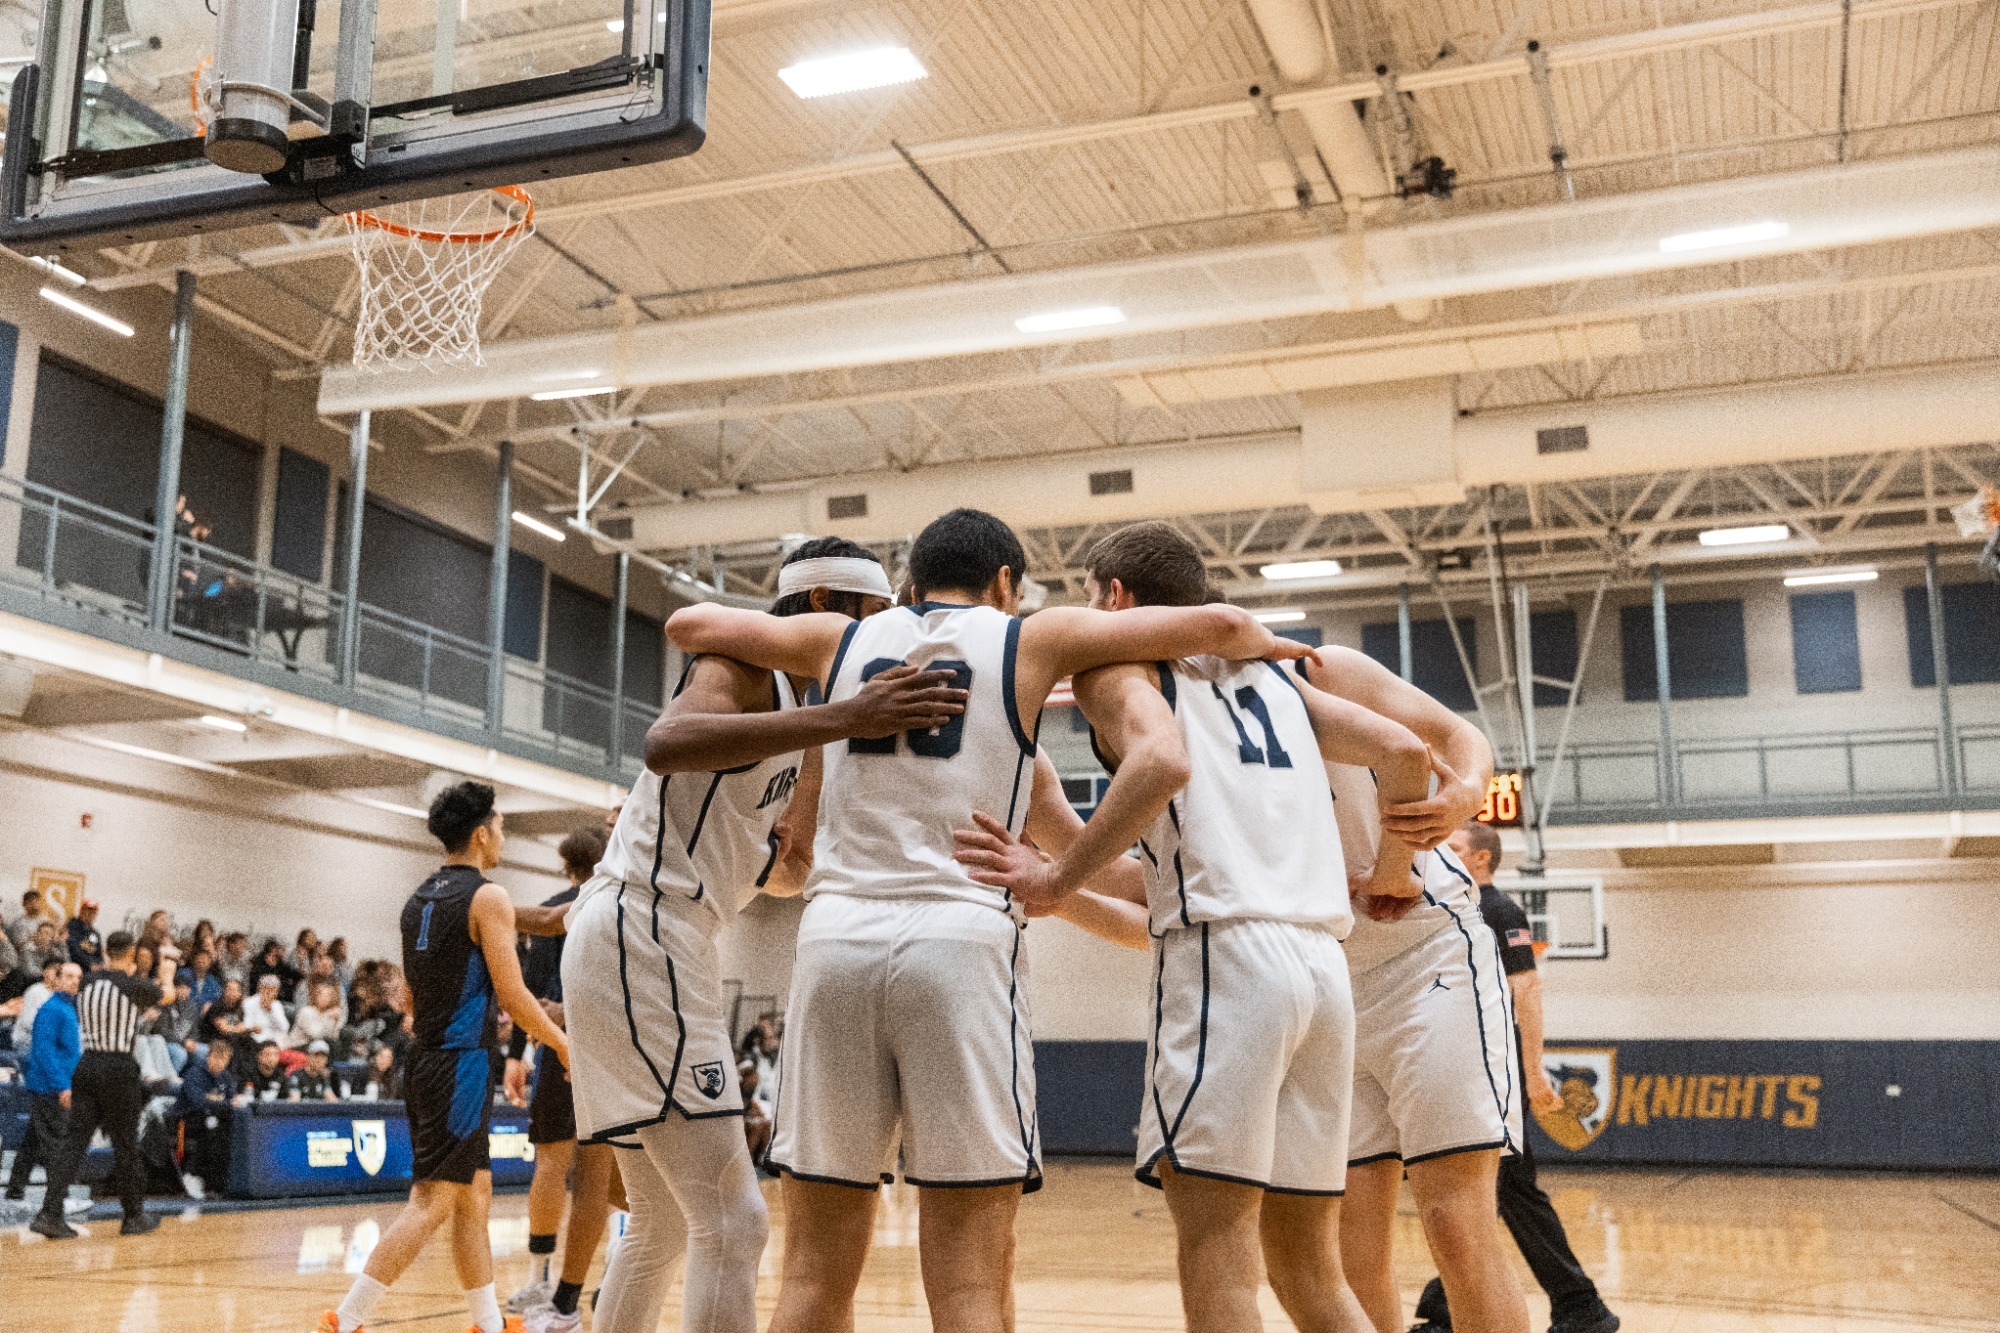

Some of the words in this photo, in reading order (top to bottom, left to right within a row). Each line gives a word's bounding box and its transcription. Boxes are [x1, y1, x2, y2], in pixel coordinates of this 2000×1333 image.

[1211, 681, 1293, 768] 11
[45, 884, 67, 927] S
[415, 900, 435, 951] 1
[1616, 1074, 1822, 1128] KNIGHTS
